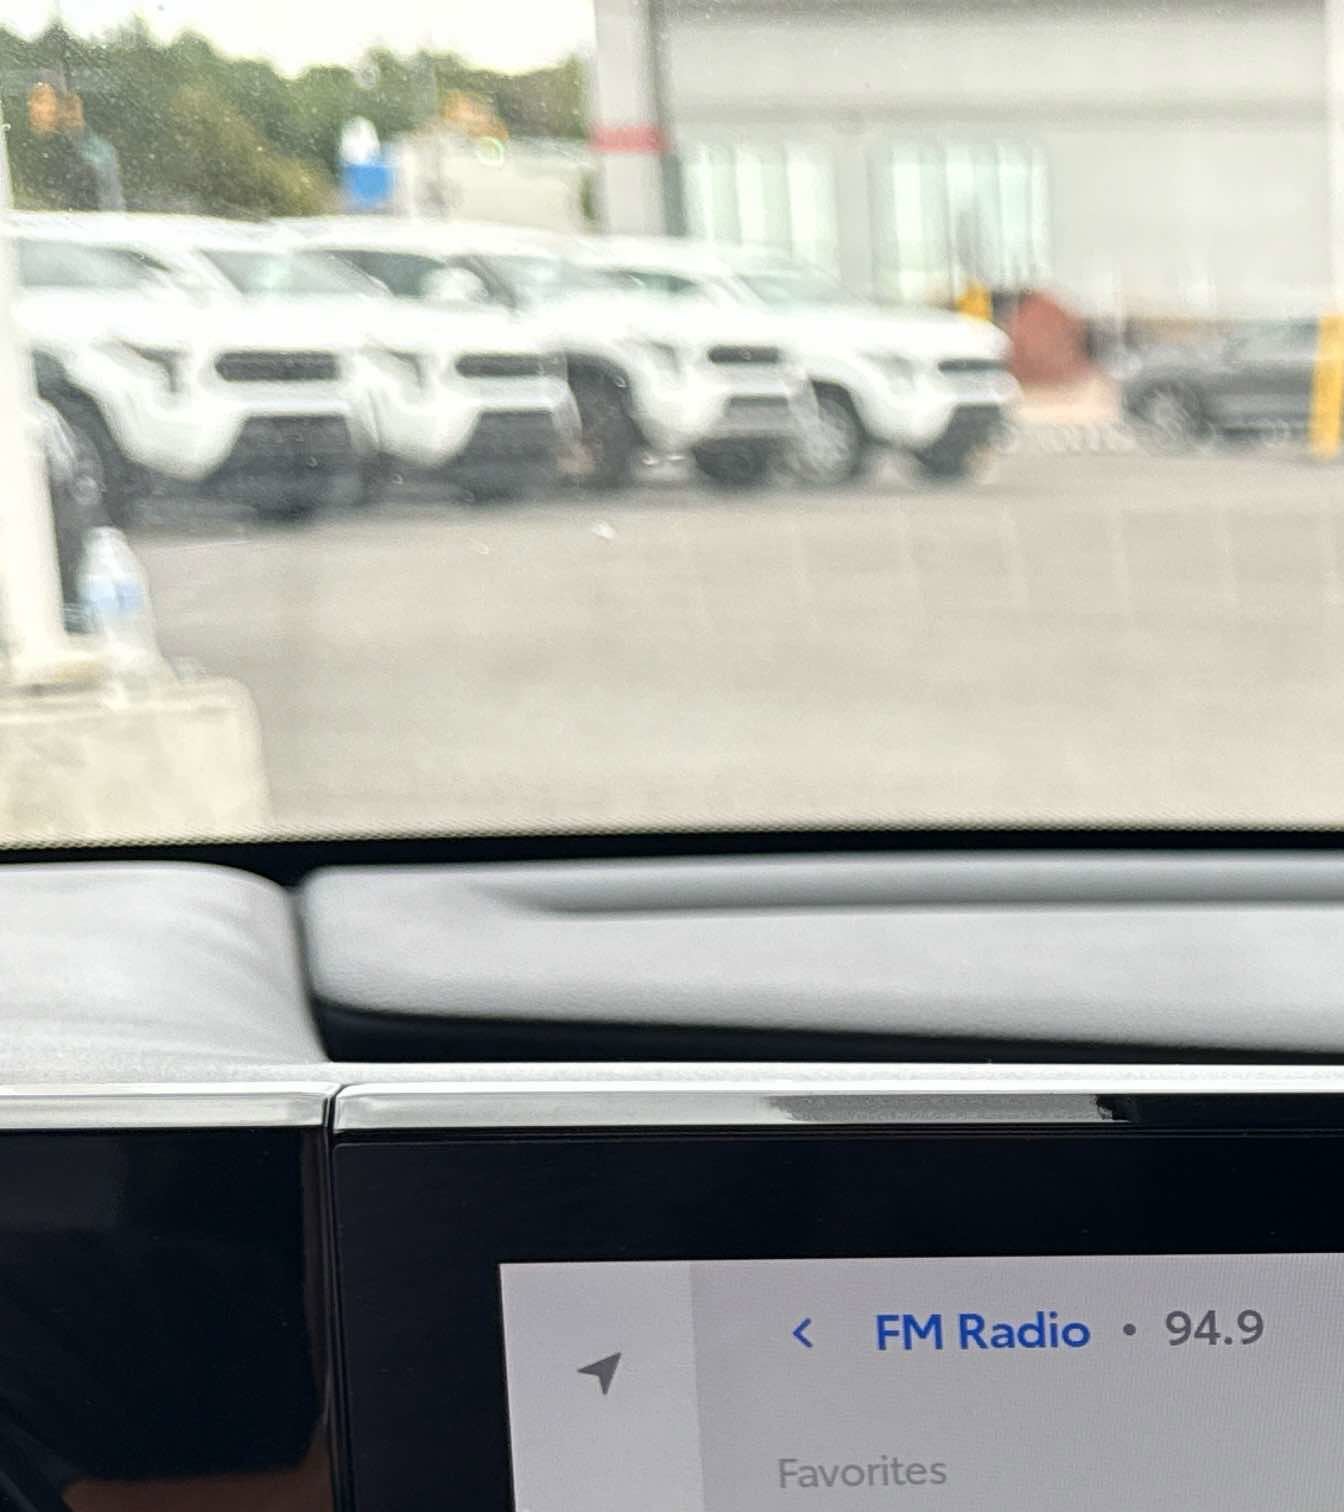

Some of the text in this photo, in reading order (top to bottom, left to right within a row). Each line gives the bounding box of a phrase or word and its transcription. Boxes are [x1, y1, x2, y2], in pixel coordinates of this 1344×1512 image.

[875, 1309, 1264, 1351] FM Radio 94.9
[777, 1454, 948, 1488] Favorites
